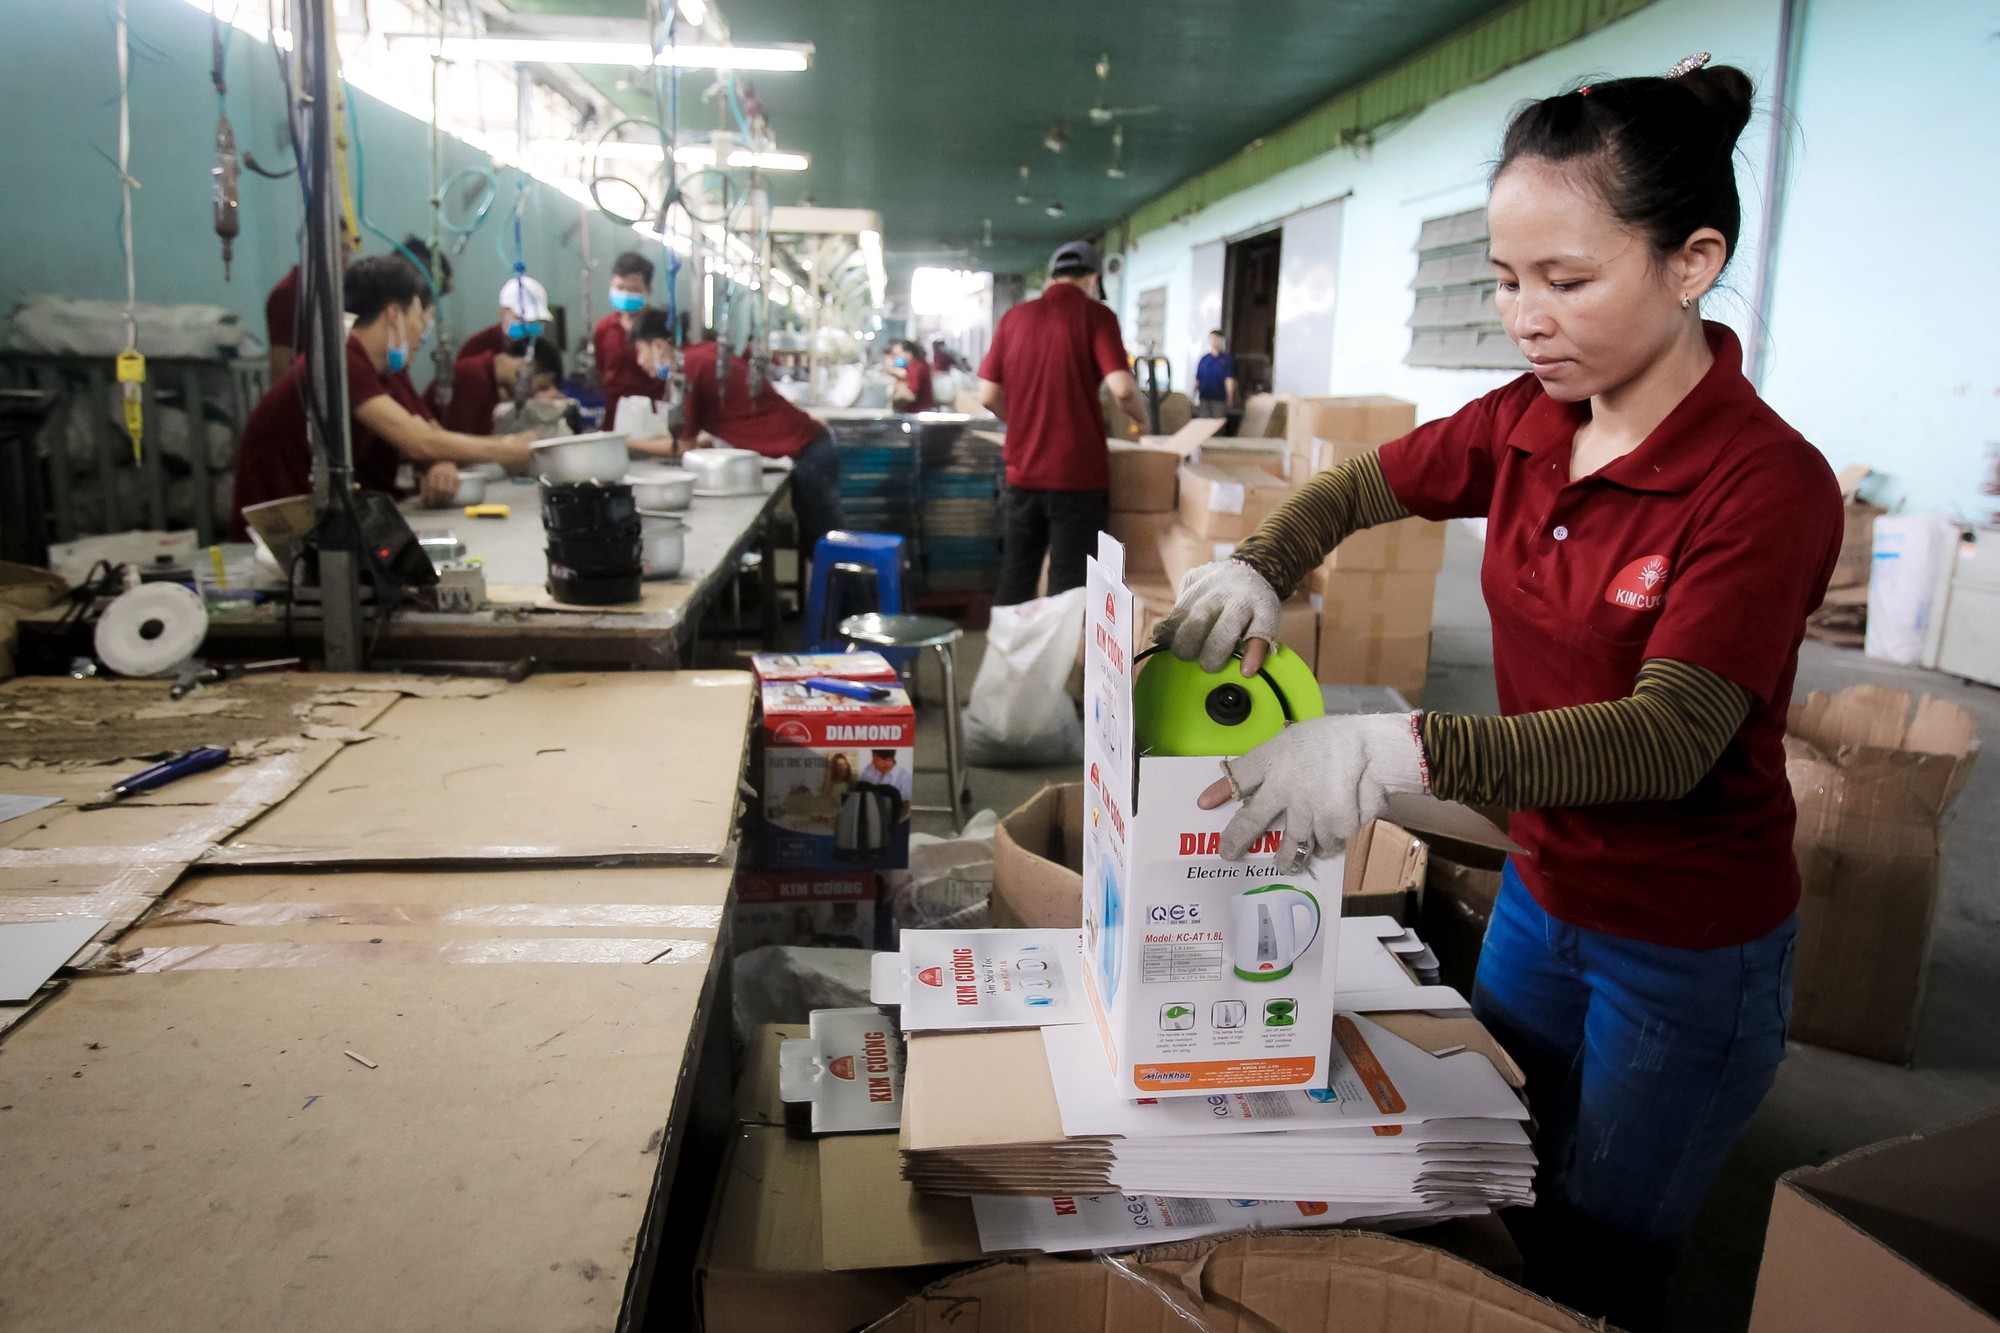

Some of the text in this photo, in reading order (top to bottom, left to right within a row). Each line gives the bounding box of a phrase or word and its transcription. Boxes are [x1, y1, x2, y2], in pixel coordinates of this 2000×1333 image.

[825, 725, 902, 741] DIAMOND
[1179, 830, 1283, 856] DIAON
[1187, 865, 1286, 879] Electric Kettl
[1145, 931, 1224, 943] Model: KC-AT 1.8L
[956, 985, 979, 1006] KIM
[868, 1077, 893, 1103] KIM
